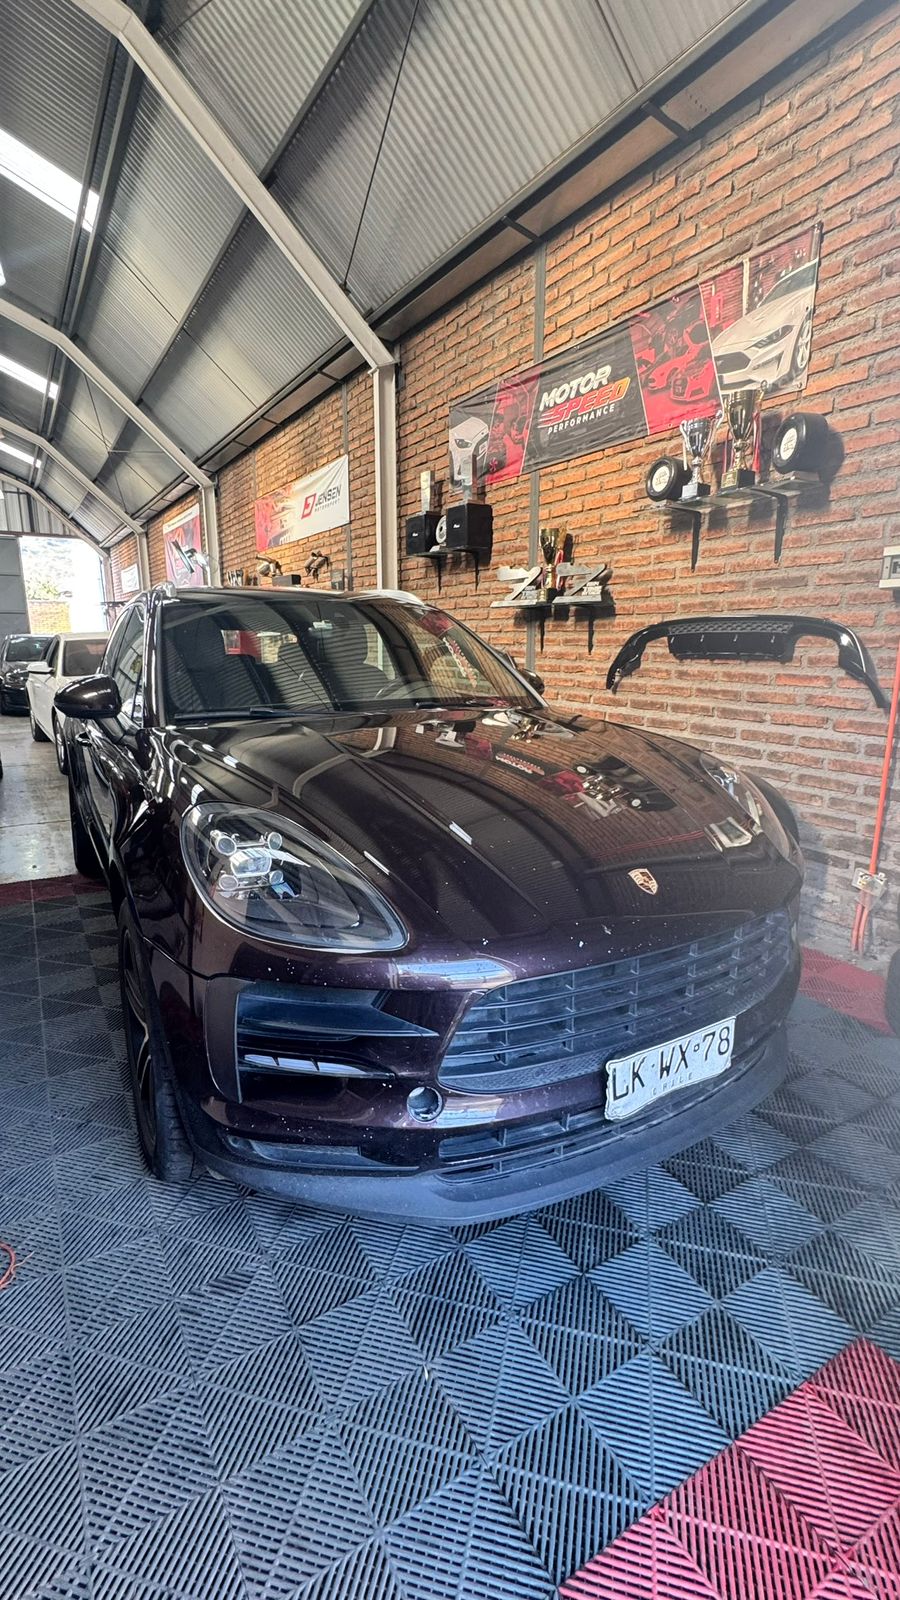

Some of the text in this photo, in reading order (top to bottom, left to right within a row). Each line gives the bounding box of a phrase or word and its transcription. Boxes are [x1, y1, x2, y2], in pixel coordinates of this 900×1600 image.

[537, 377, 631, 429] SPEED
[538, 364, 612, 412] MOTOR
[547, 404, 616, 435] PERFORMANCE
[652, 1073, 693, 1095] CHILE
